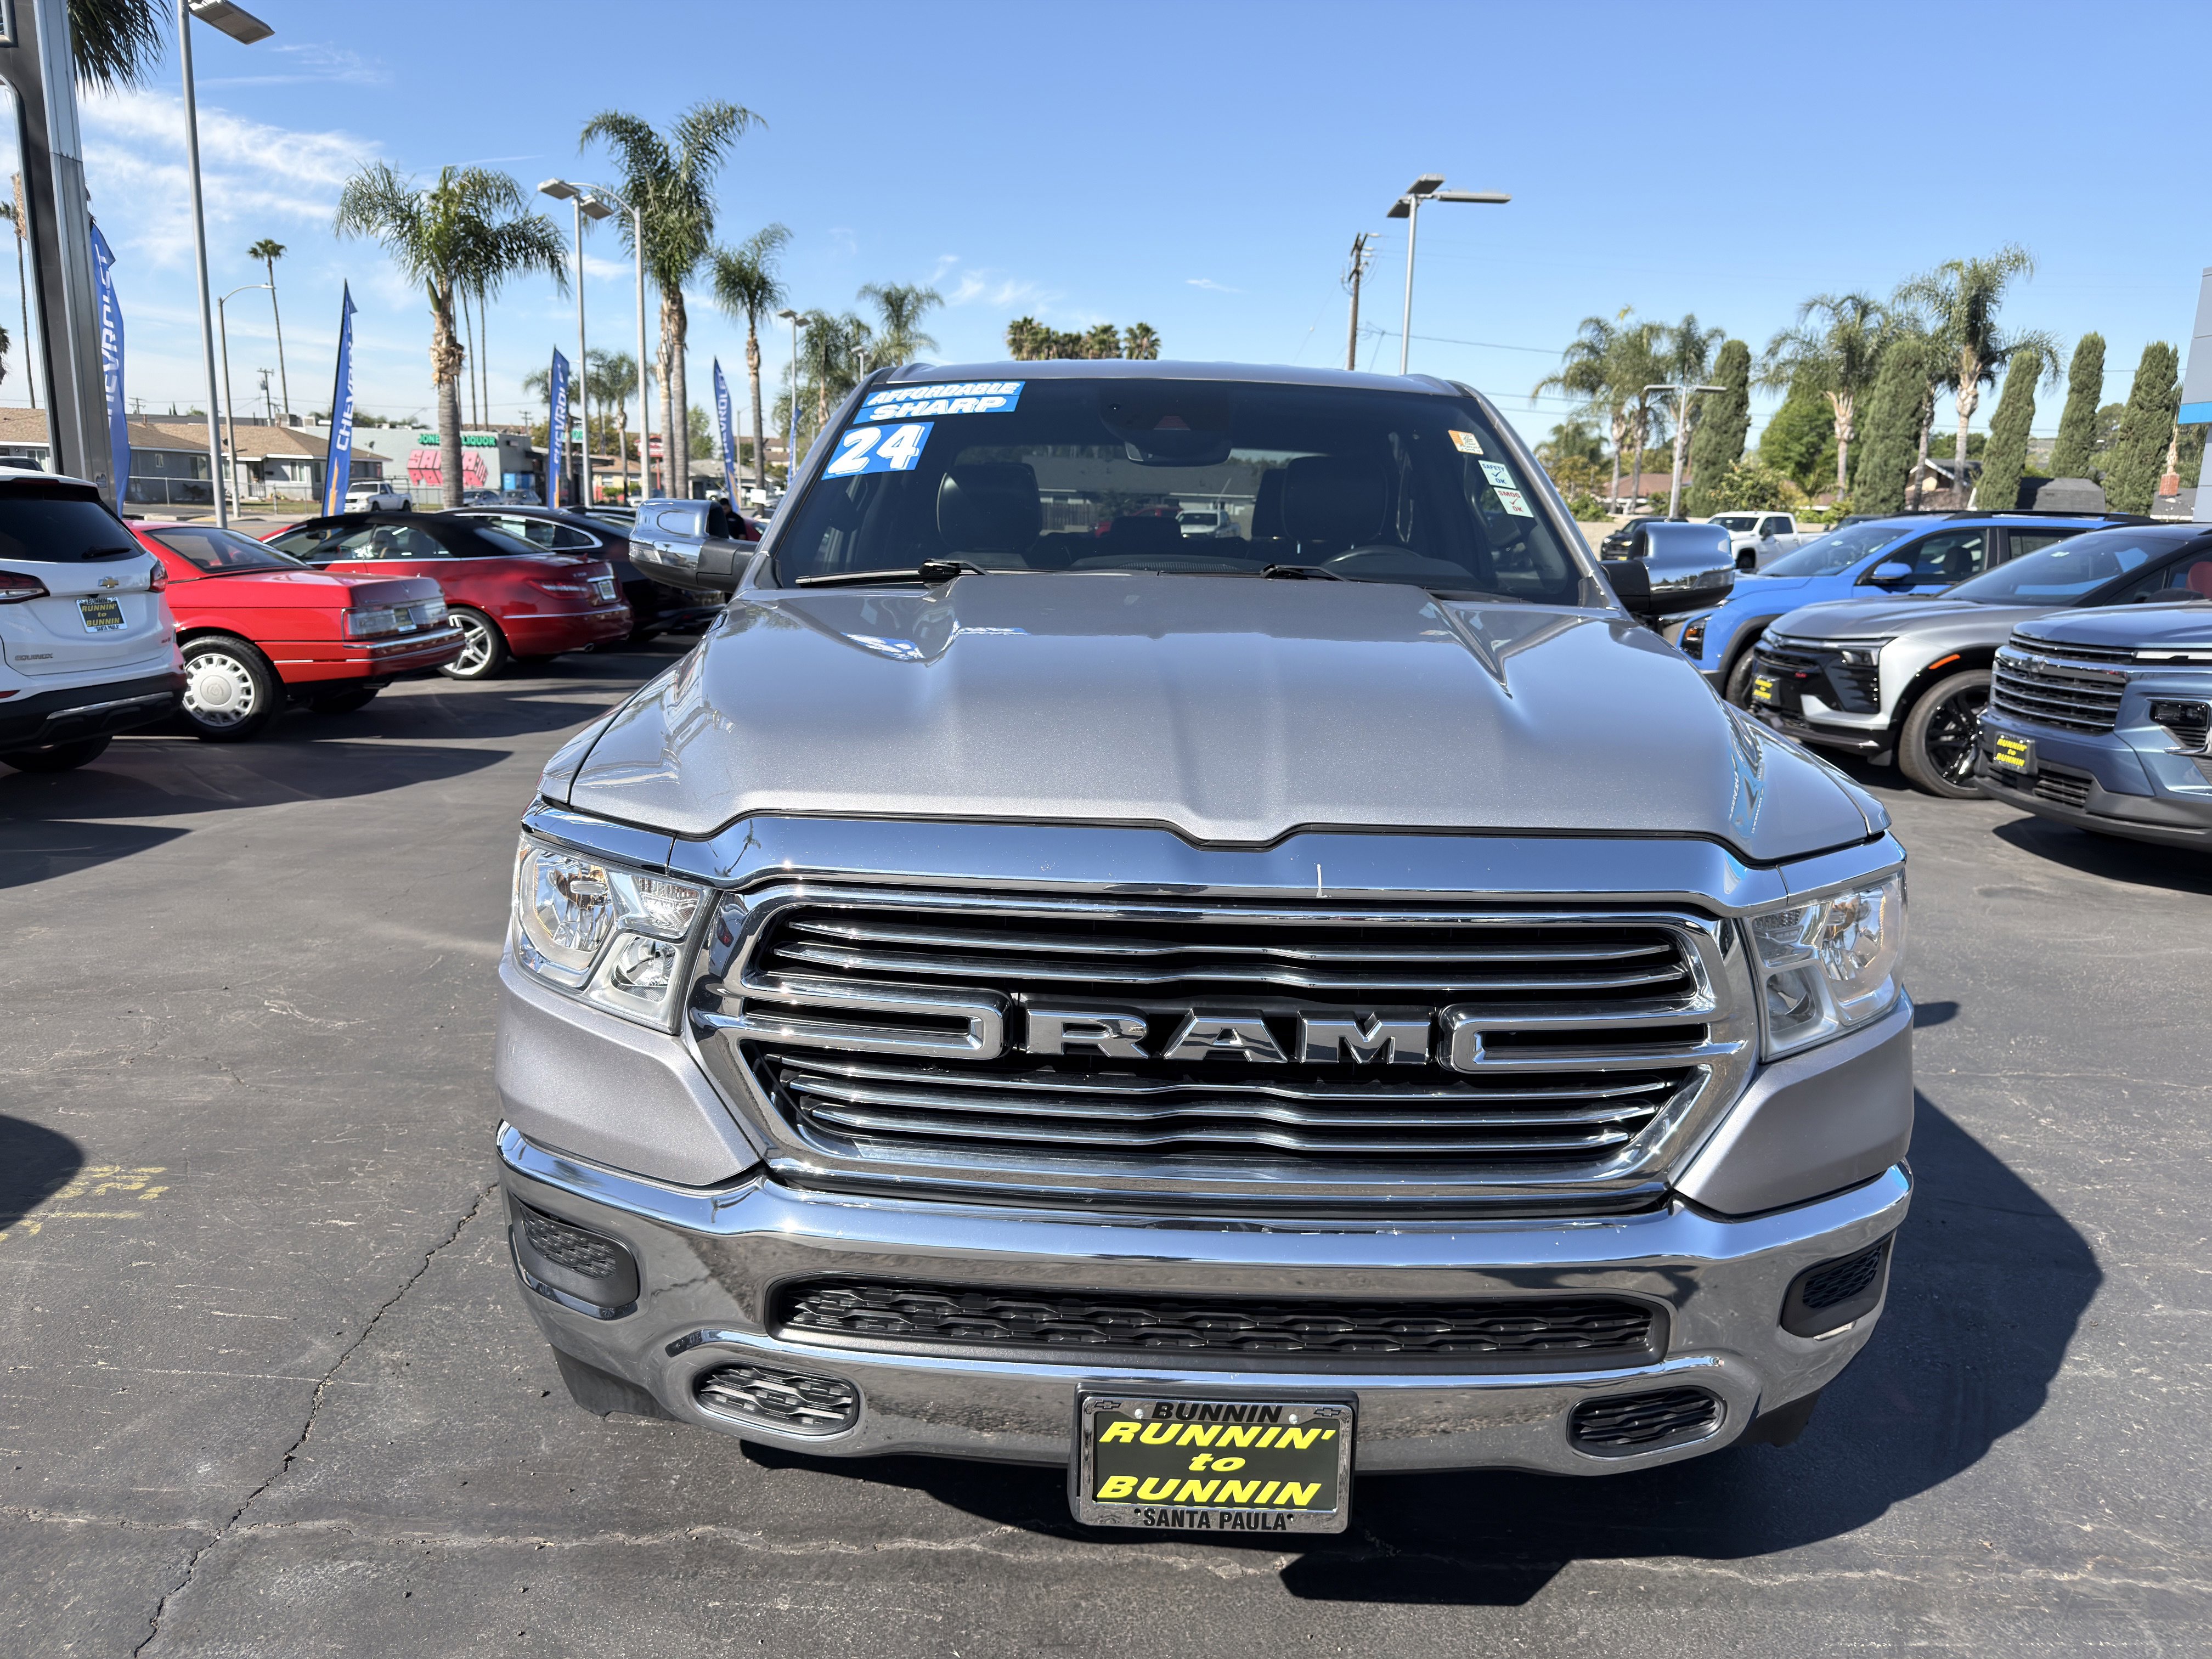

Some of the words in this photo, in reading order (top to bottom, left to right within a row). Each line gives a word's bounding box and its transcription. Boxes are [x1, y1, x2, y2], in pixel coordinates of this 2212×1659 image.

[95, 244, 119, 432] HEVROLET
[867, 382, 1020, 405] AFFORDABLE
[870, 396, 1007, 421] SHARP
[418, 433, 441, 445] JONE
[462, 436, 496, 447] LIQUOR
[828, 425, 926, 475] 24
[1482, 464, 1505, 472] SAFETY
[1498, 490, 1521, 498] SMOG
[82, 603, 117, 612] RUNNIN'
[86, 618, 120, 627] BUNNIN
[1025, 1007, 1432, 1065] RAM
[1152, 1401, 1283, 1424] BUNNIN
[1099, 1421, 1336, 1449] RUNNIN'
[1188, 1453, 1246, 1472] to
[1096, 1475, 1322, 1506] BUNNIN
[1143, 1509, 1210, 1528] SANTA
[1218, 1511, 1287, 1531] PAULA
